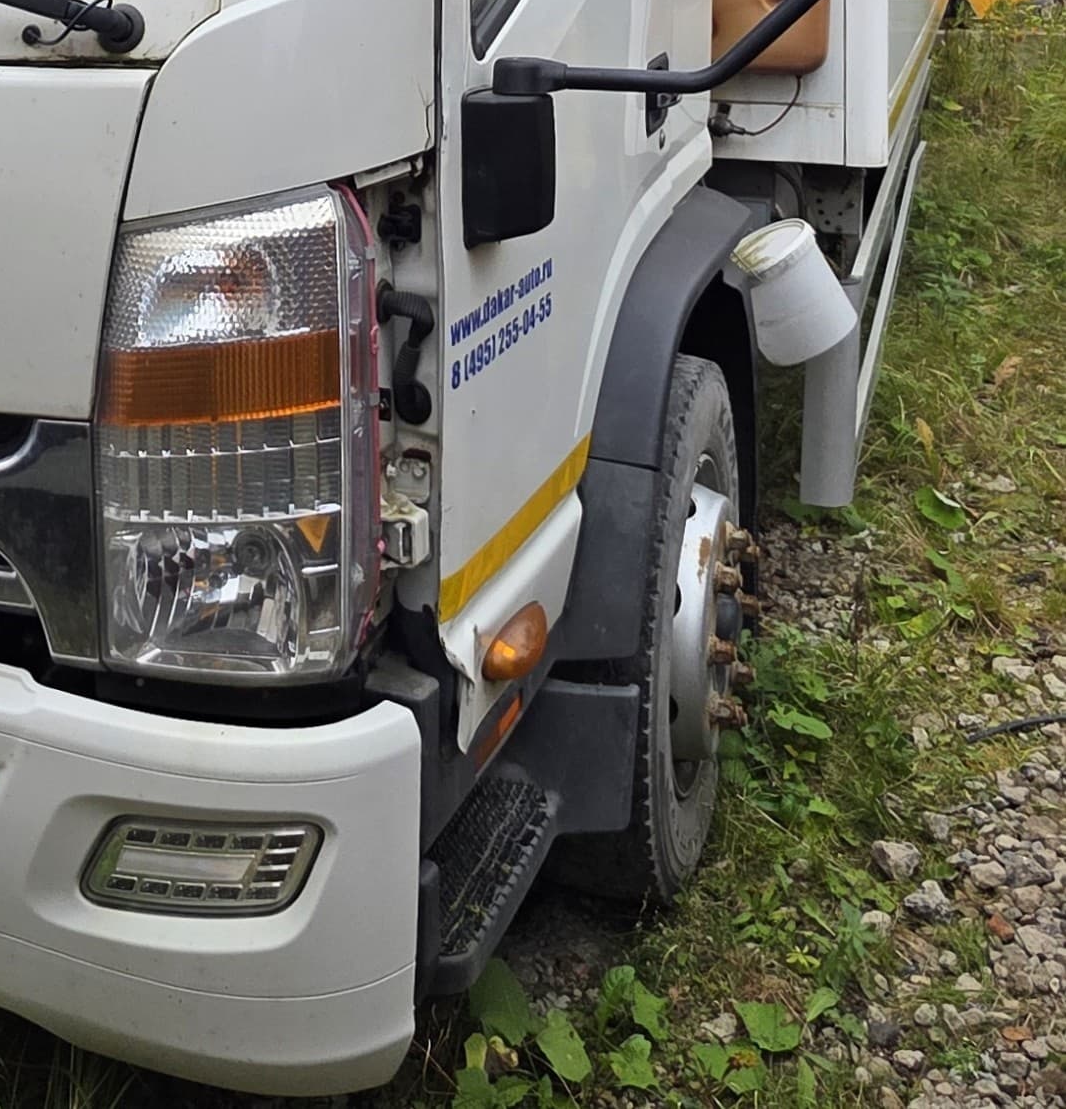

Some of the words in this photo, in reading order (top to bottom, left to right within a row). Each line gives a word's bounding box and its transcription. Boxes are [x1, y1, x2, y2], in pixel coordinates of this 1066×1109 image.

[450, 258, 553, 346] www.dakar-auto.ru
[451, 360, 461, 390] 8
[464, 333, 496, 382] (495)
[497, 292, 552, 355] 255-04-55
